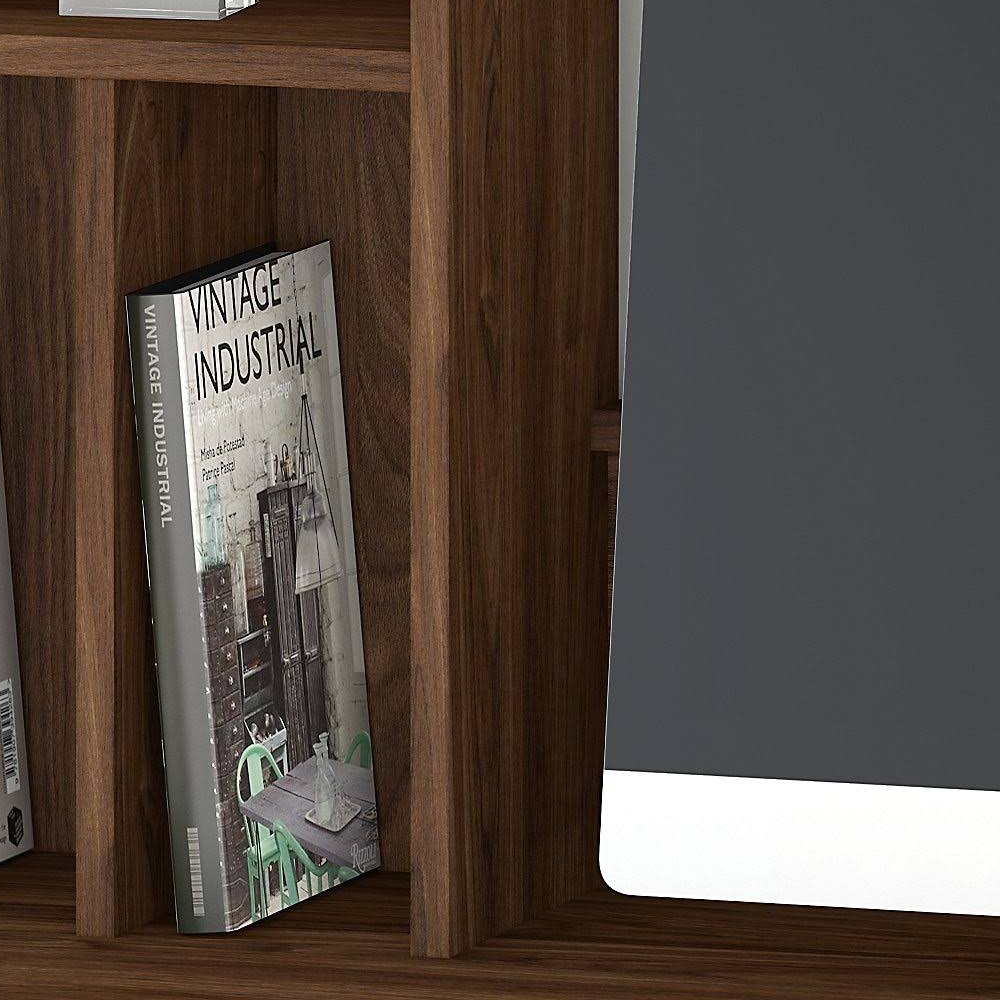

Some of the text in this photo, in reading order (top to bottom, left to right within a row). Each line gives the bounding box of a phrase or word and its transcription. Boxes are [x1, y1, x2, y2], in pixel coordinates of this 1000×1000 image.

[189, 258, 282, 334] VINTAGE
[194, 311, 323, 401] INDUSTRIAL
[144, 304, 173, 528] VINTAGE INDUSTRIAL
